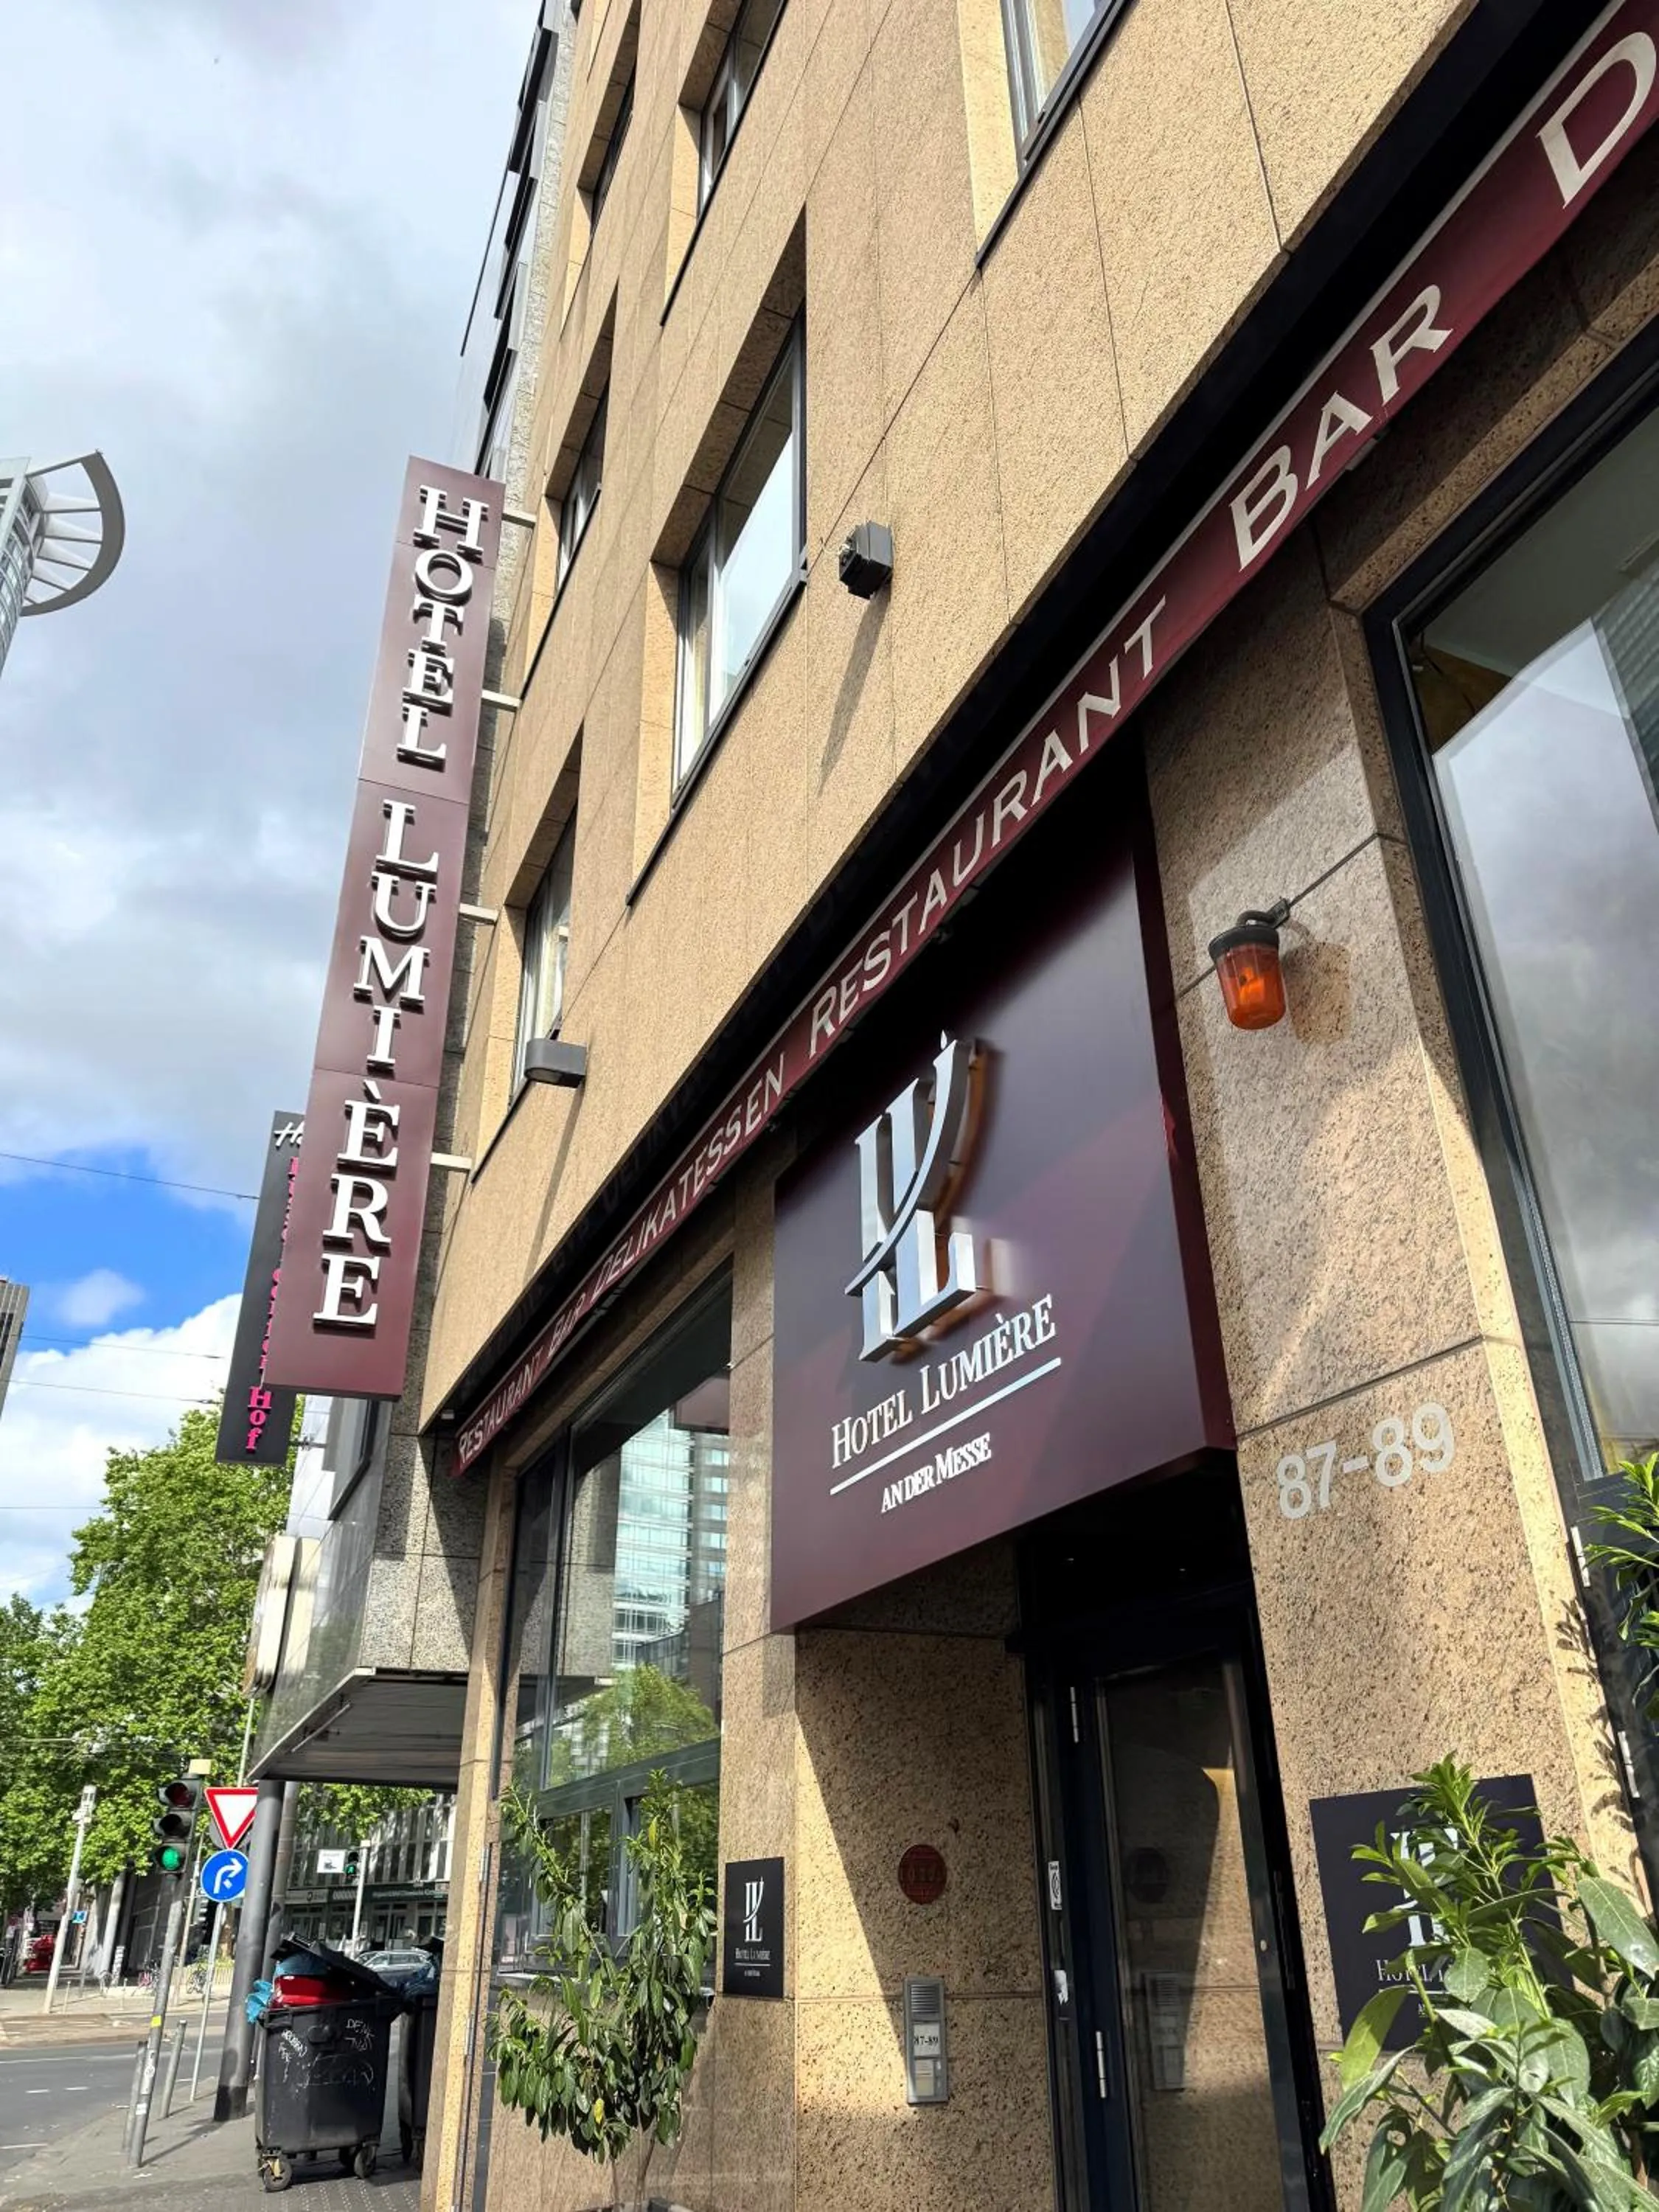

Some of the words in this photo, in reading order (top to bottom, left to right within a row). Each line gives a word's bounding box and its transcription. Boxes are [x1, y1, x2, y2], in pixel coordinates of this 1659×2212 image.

[396, 484, 490, 767] HOTEL
[459, 1344, 544, 1464] RESTAURANT
[591, 1054, 787, 1303] DELIKATESSEN
[808, 594, 1166, 1058] RESTAURANT
[1228, 283, 1454, 573] BAR
[313, 798, 440, 1333] LUMIÈRE
[831, 1389, 914, 1469] HOTEL
[919, 1293, 1057, 1415] LUMIÈRE
[934, 1431, 992, 1485] MESSE
[1276, 1401, 1457, 1520] 87-89
